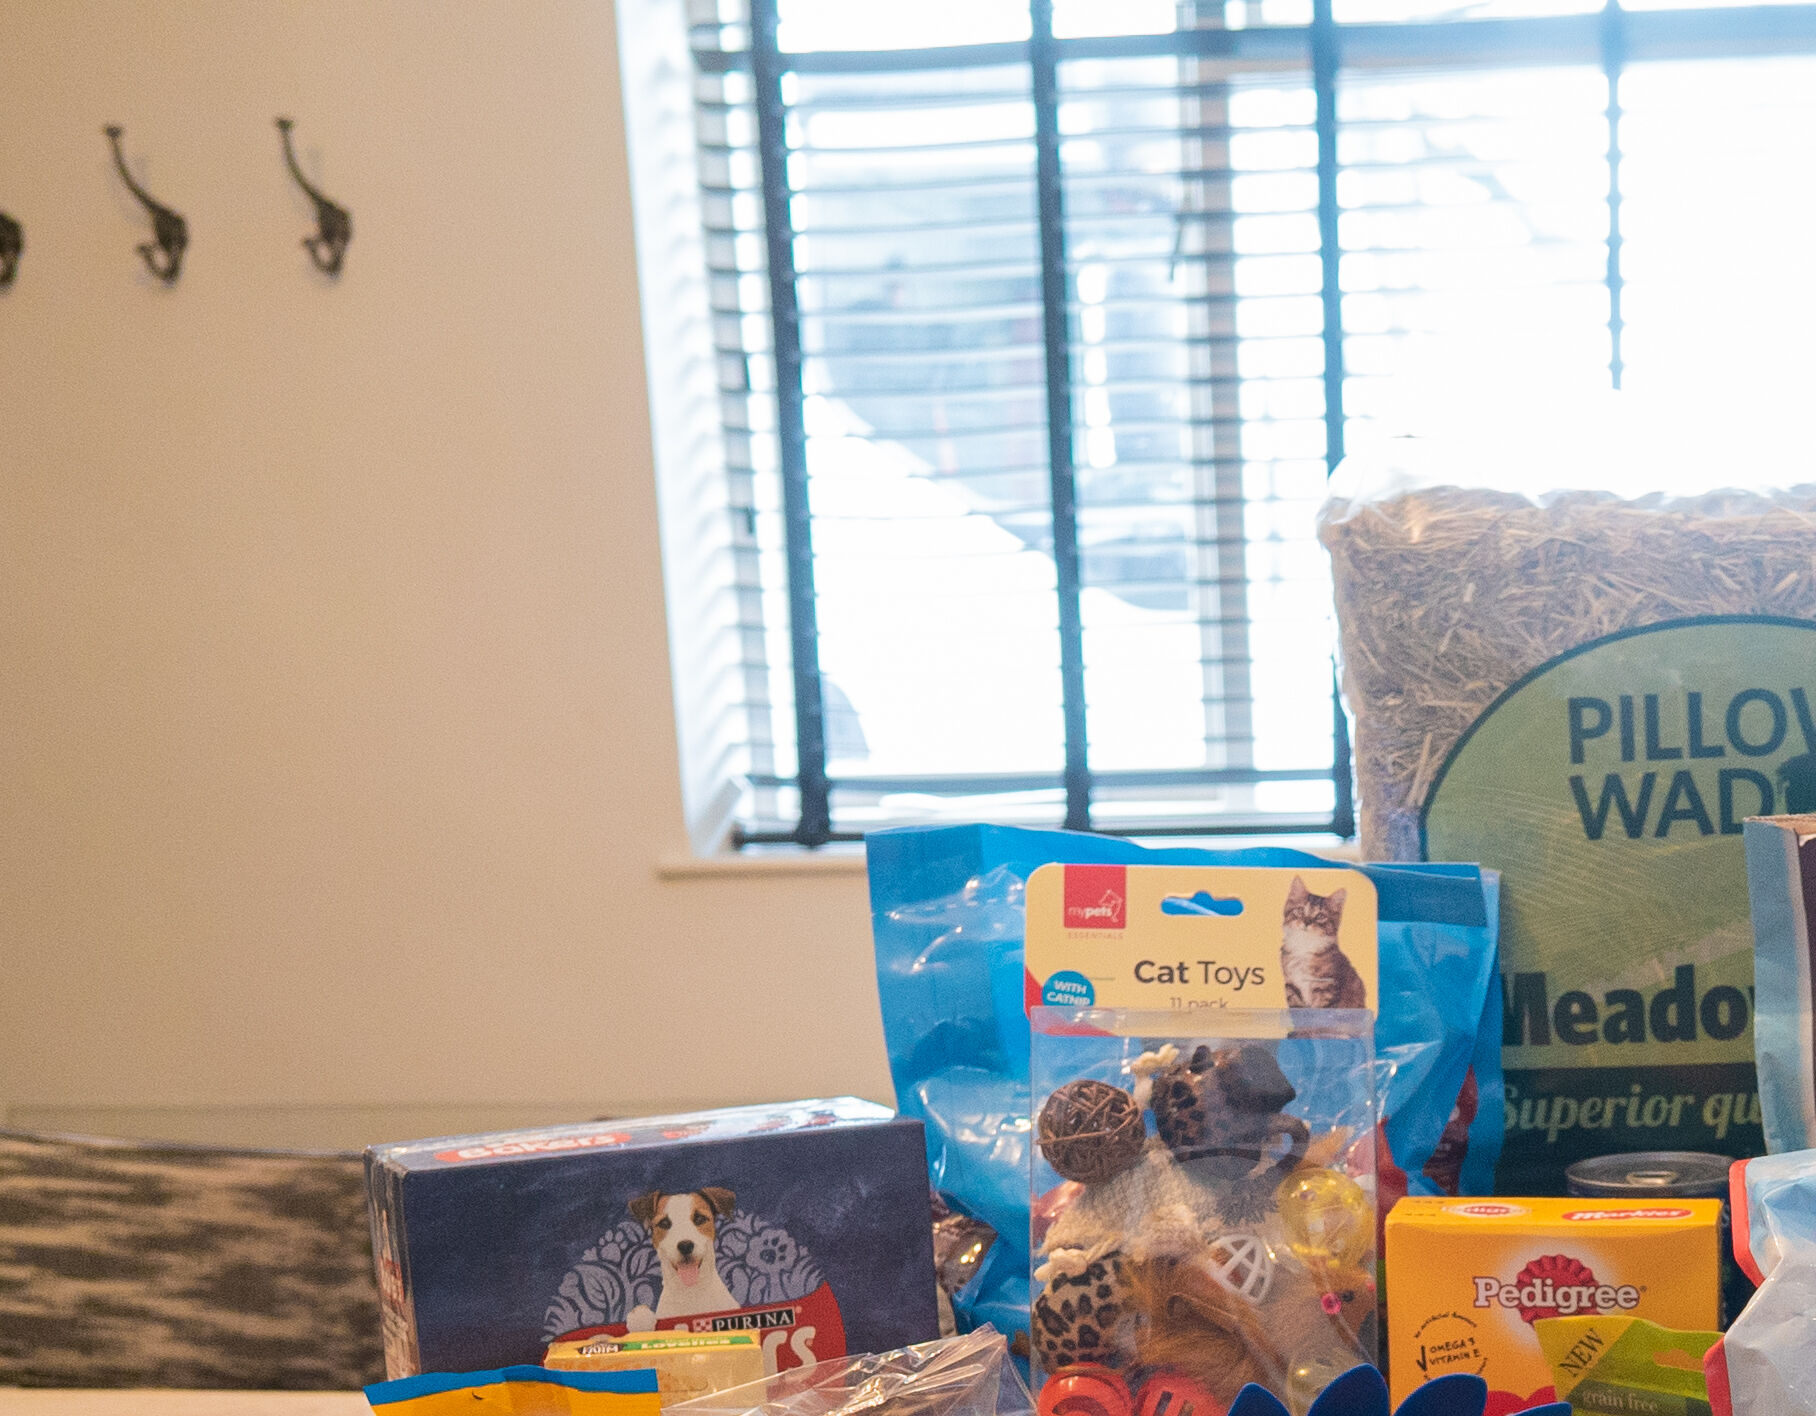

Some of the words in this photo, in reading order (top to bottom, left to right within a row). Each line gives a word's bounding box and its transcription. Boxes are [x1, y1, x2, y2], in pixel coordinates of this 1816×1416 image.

[1134, 961, 1189, 985] Cat
[1198, 961, 1266, 991] Toys
[1502, 964, 1754, 1046] Meado
[1503, 1083, 1696, 1142] Superior
[1473, 1276, 1640, 1315] Pedigree
[714, 1309, 792, 1332] PURINA
[1558, 1327, 1606, 1378] NEW
